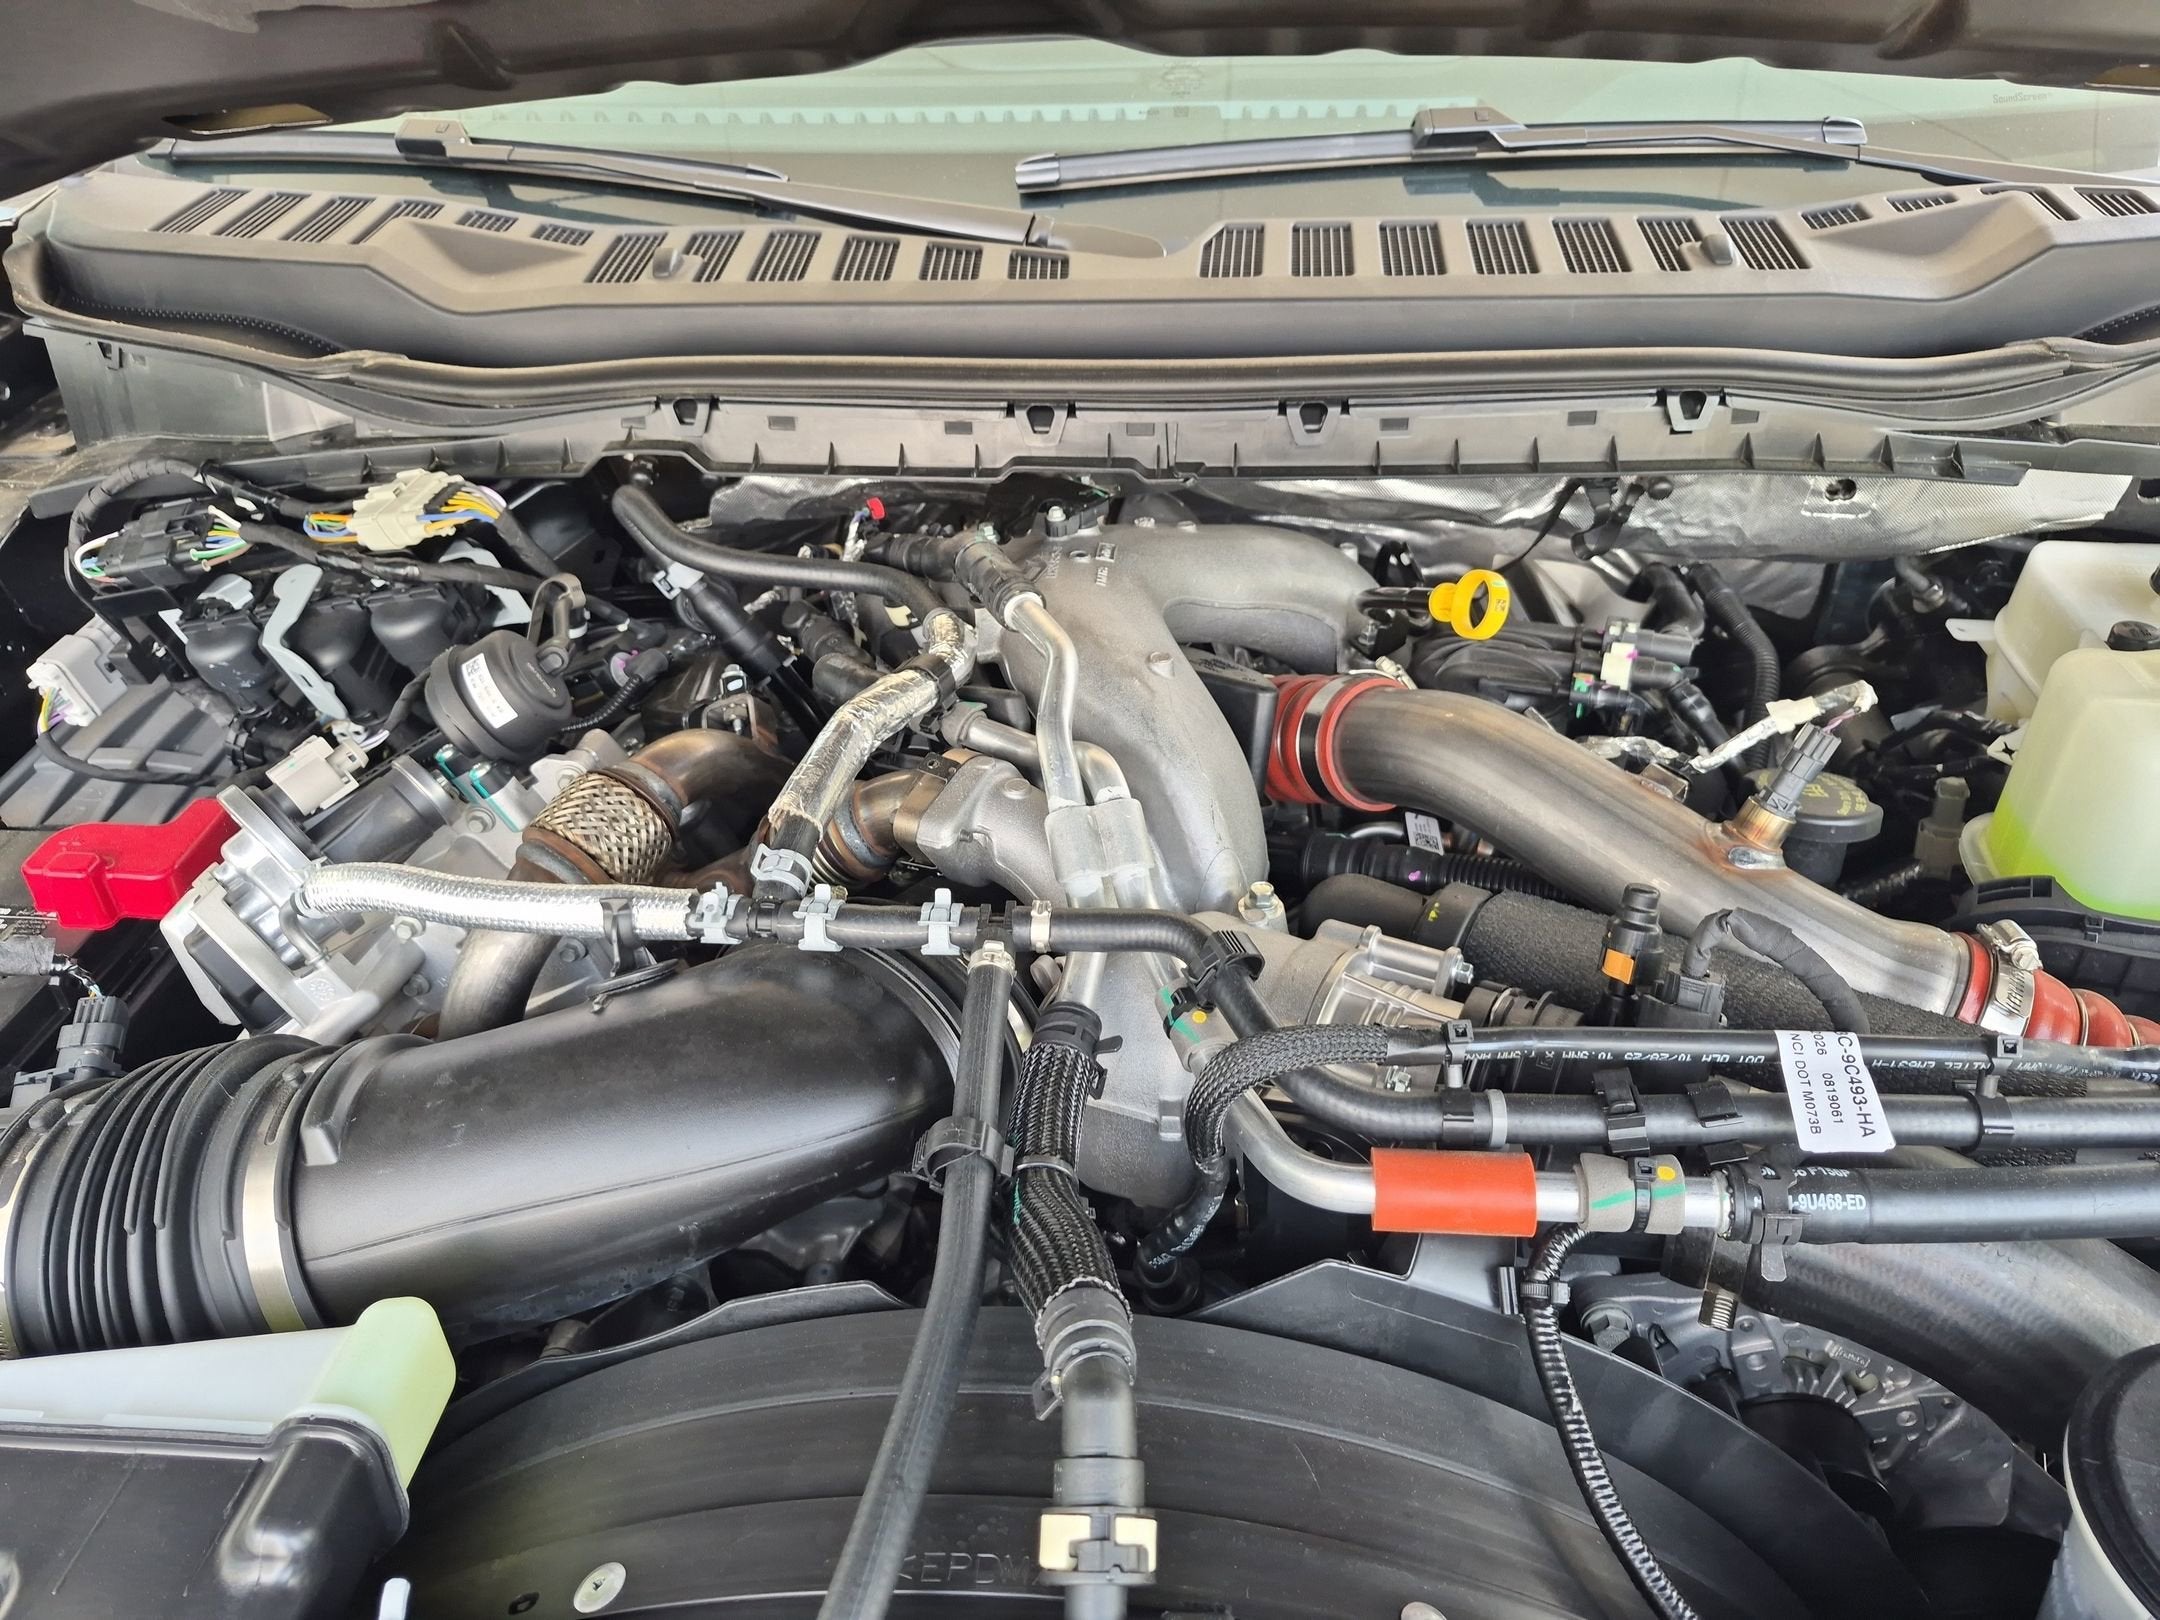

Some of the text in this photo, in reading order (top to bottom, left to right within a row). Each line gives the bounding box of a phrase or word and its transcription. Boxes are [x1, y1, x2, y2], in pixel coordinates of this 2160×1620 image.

[1795, 1060, 1812, 1087] DOT
[1811, 1031, 1844, 1124] 026 0819061
[1802, 1090, 1822, 1135] M073B
